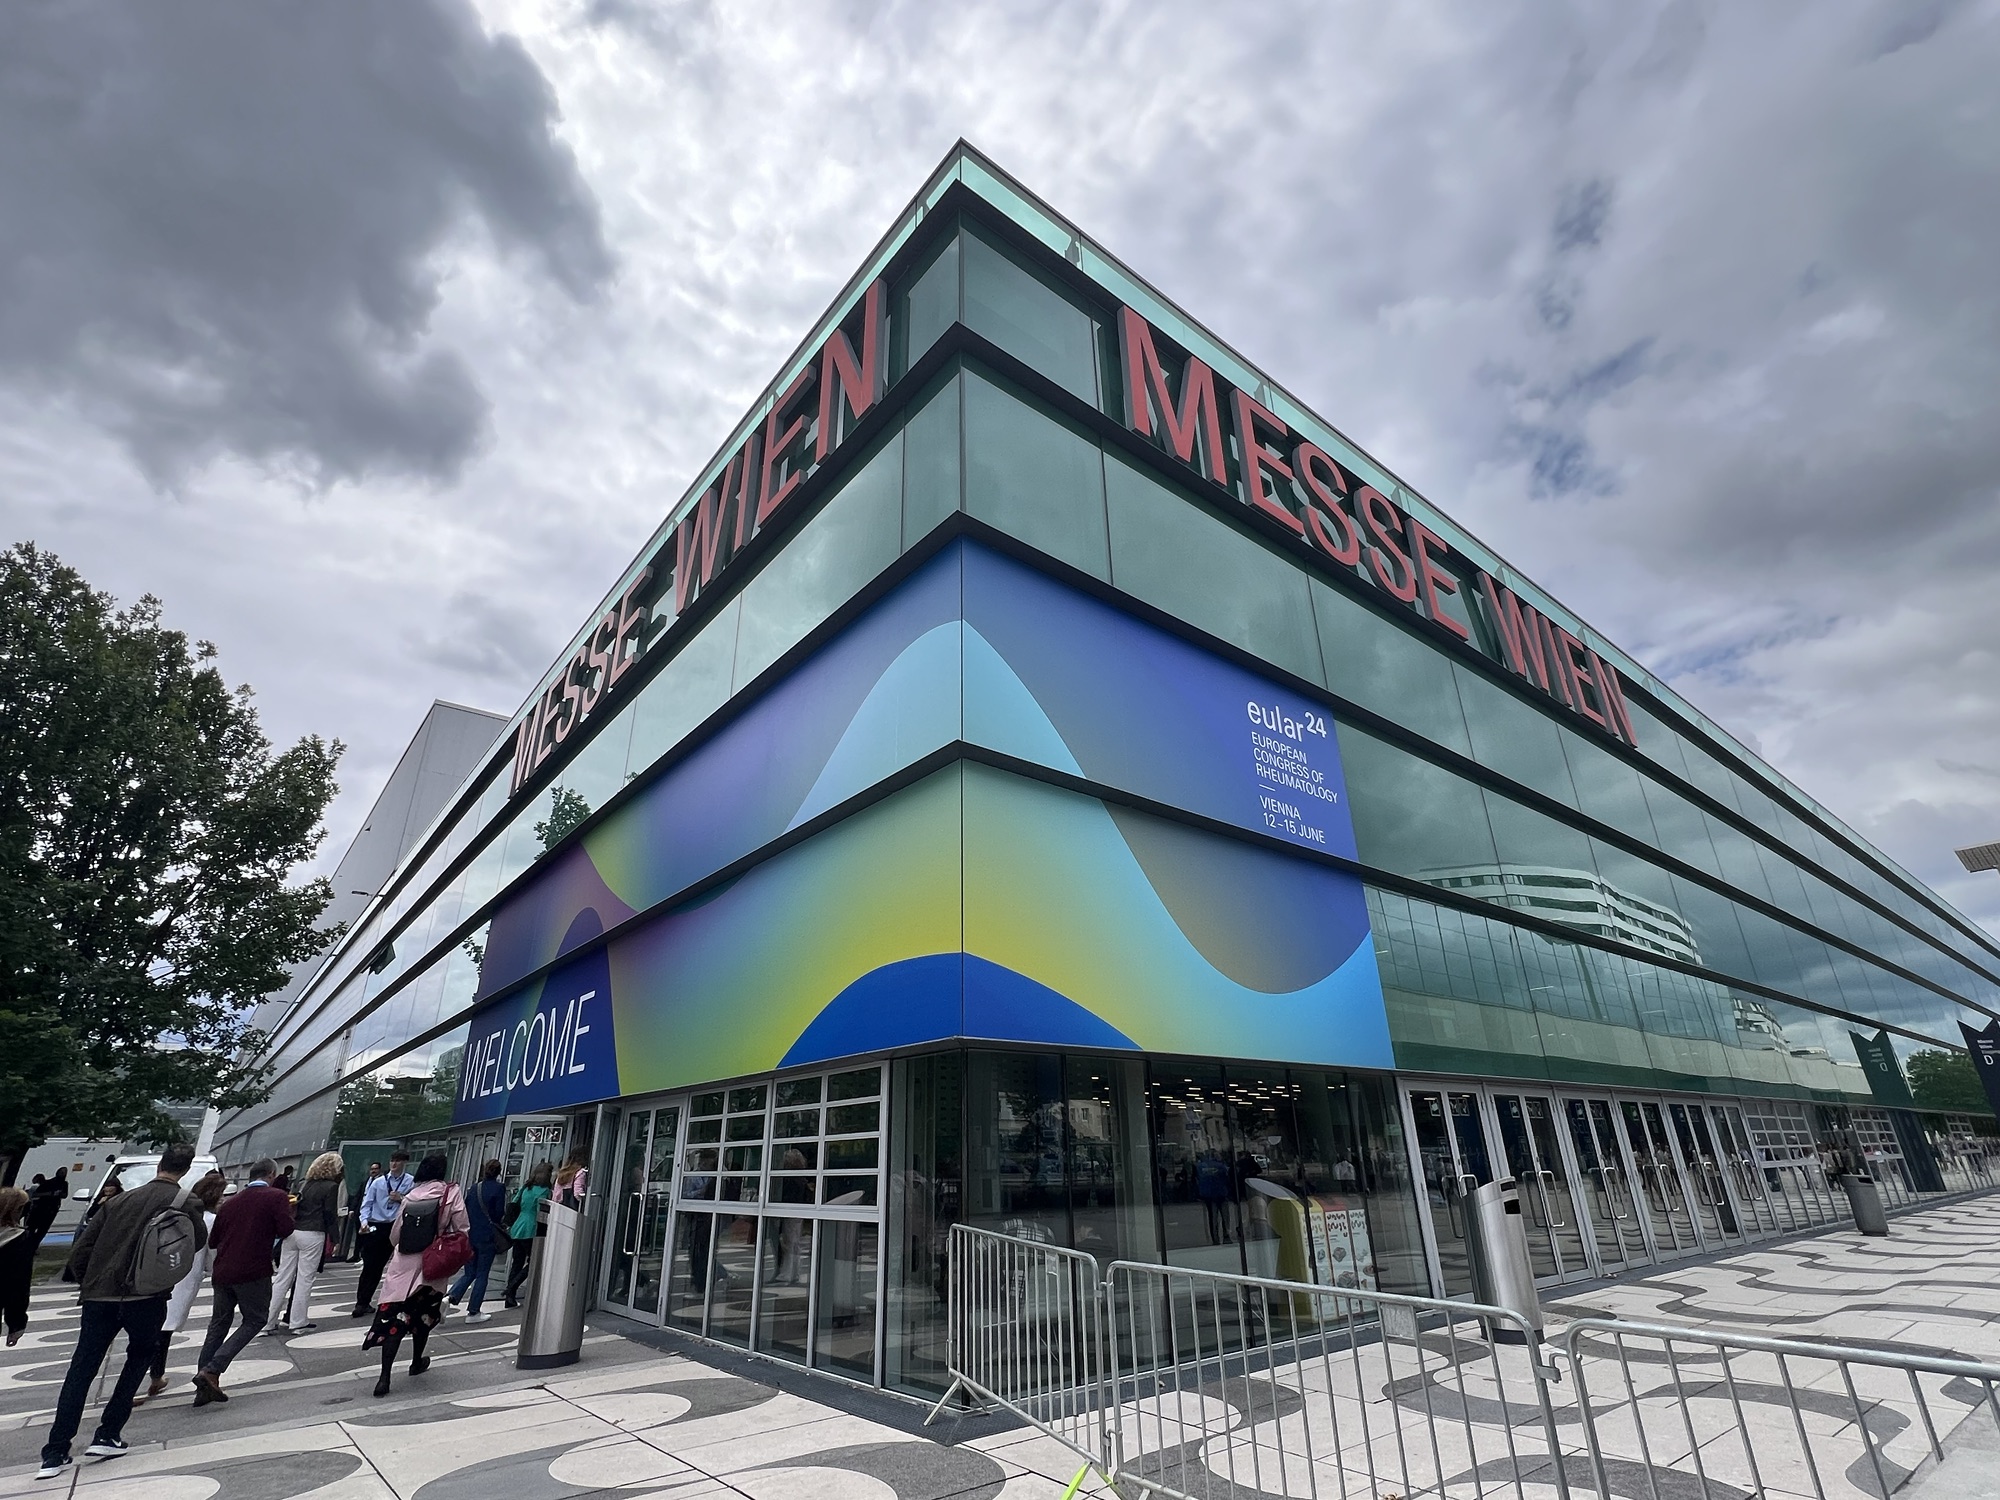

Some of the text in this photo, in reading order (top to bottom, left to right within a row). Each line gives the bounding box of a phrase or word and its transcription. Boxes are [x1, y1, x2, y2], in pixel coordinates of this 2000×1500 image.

[508, 278, 888, 799] MESSE WIEN
[1117, 304, 1639, 749] MESSE WIEN
[1251, 731, 1307, 764] EUROPEAN
[1253, 747, 1324, 785] CONGRESS OF
[1256, 762, 1338, 804] RHEUMATOLOGY
[1259, 795, 1302, 821] VIENNA
[1298, 824, 1326, 844] JUNE
[462, 990, 596, 1102] WELCOME
